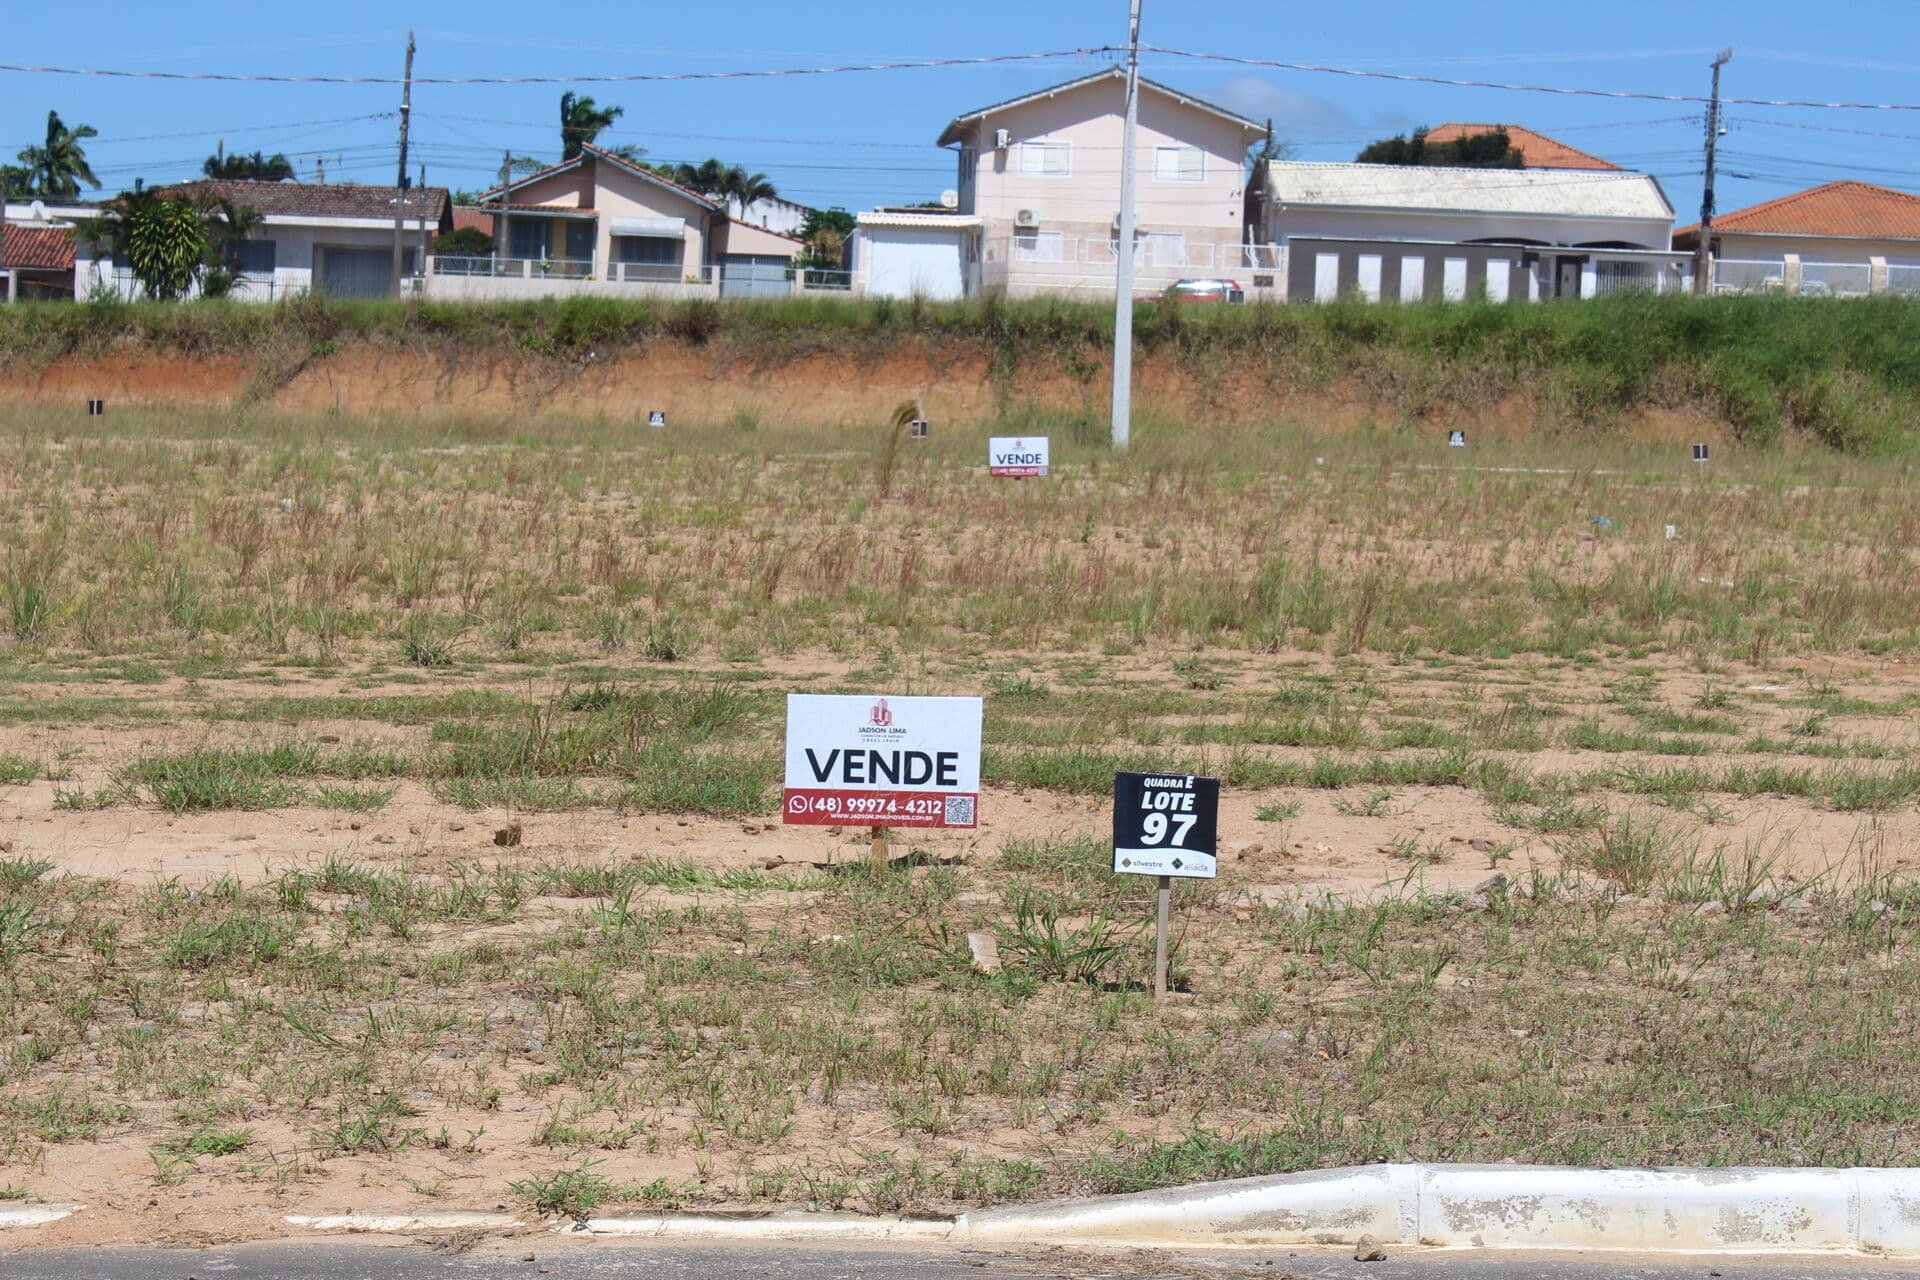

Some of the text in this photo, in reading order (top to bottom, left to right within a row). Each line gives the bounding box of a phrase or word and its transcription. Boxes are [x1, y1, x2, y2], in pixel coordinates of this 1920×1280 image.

[996, 453, 1042, 465] VENDE
[889, 727, 907, 735] LIMA
[804, 748, 959, 786] VENDE
[1144, 776, 1195, 789] QUADRA E
[809, 796, 942, 814] (48) 99974-4212
[1141, 791, 1196, 811] LOTE
[1140, 812, 1198, 847] 97
[1133, 860, 1163, 868] silvestre
